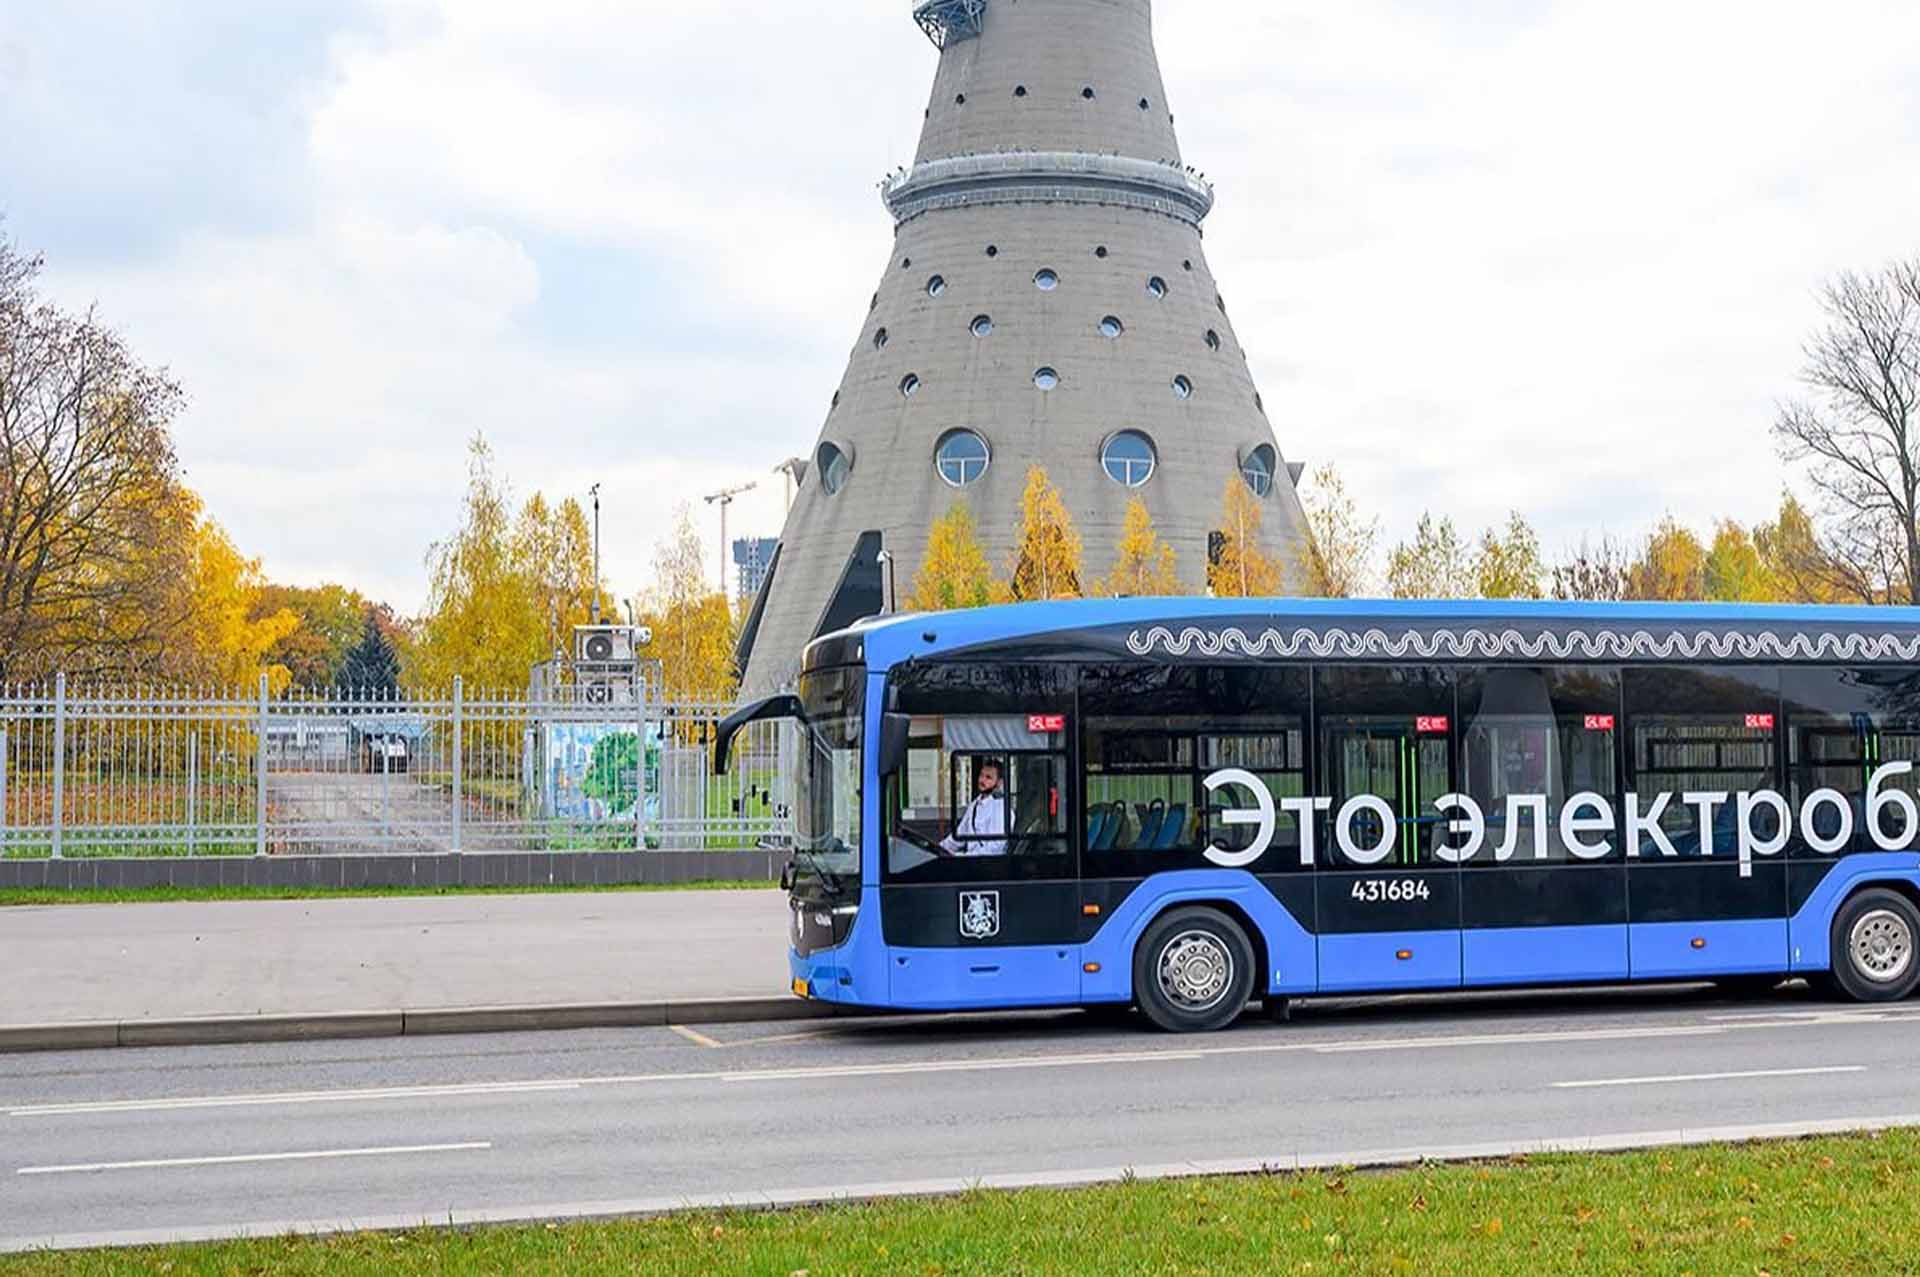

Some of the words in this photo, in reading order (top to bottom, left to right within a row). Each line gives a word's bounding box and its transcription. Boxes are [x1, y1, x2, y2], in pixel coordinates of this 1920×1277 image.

[1202, 767, 1397, 867] Это
[1433, 760, 1920, 877] электроб
[1351, 879, 1430, 901] 431684
